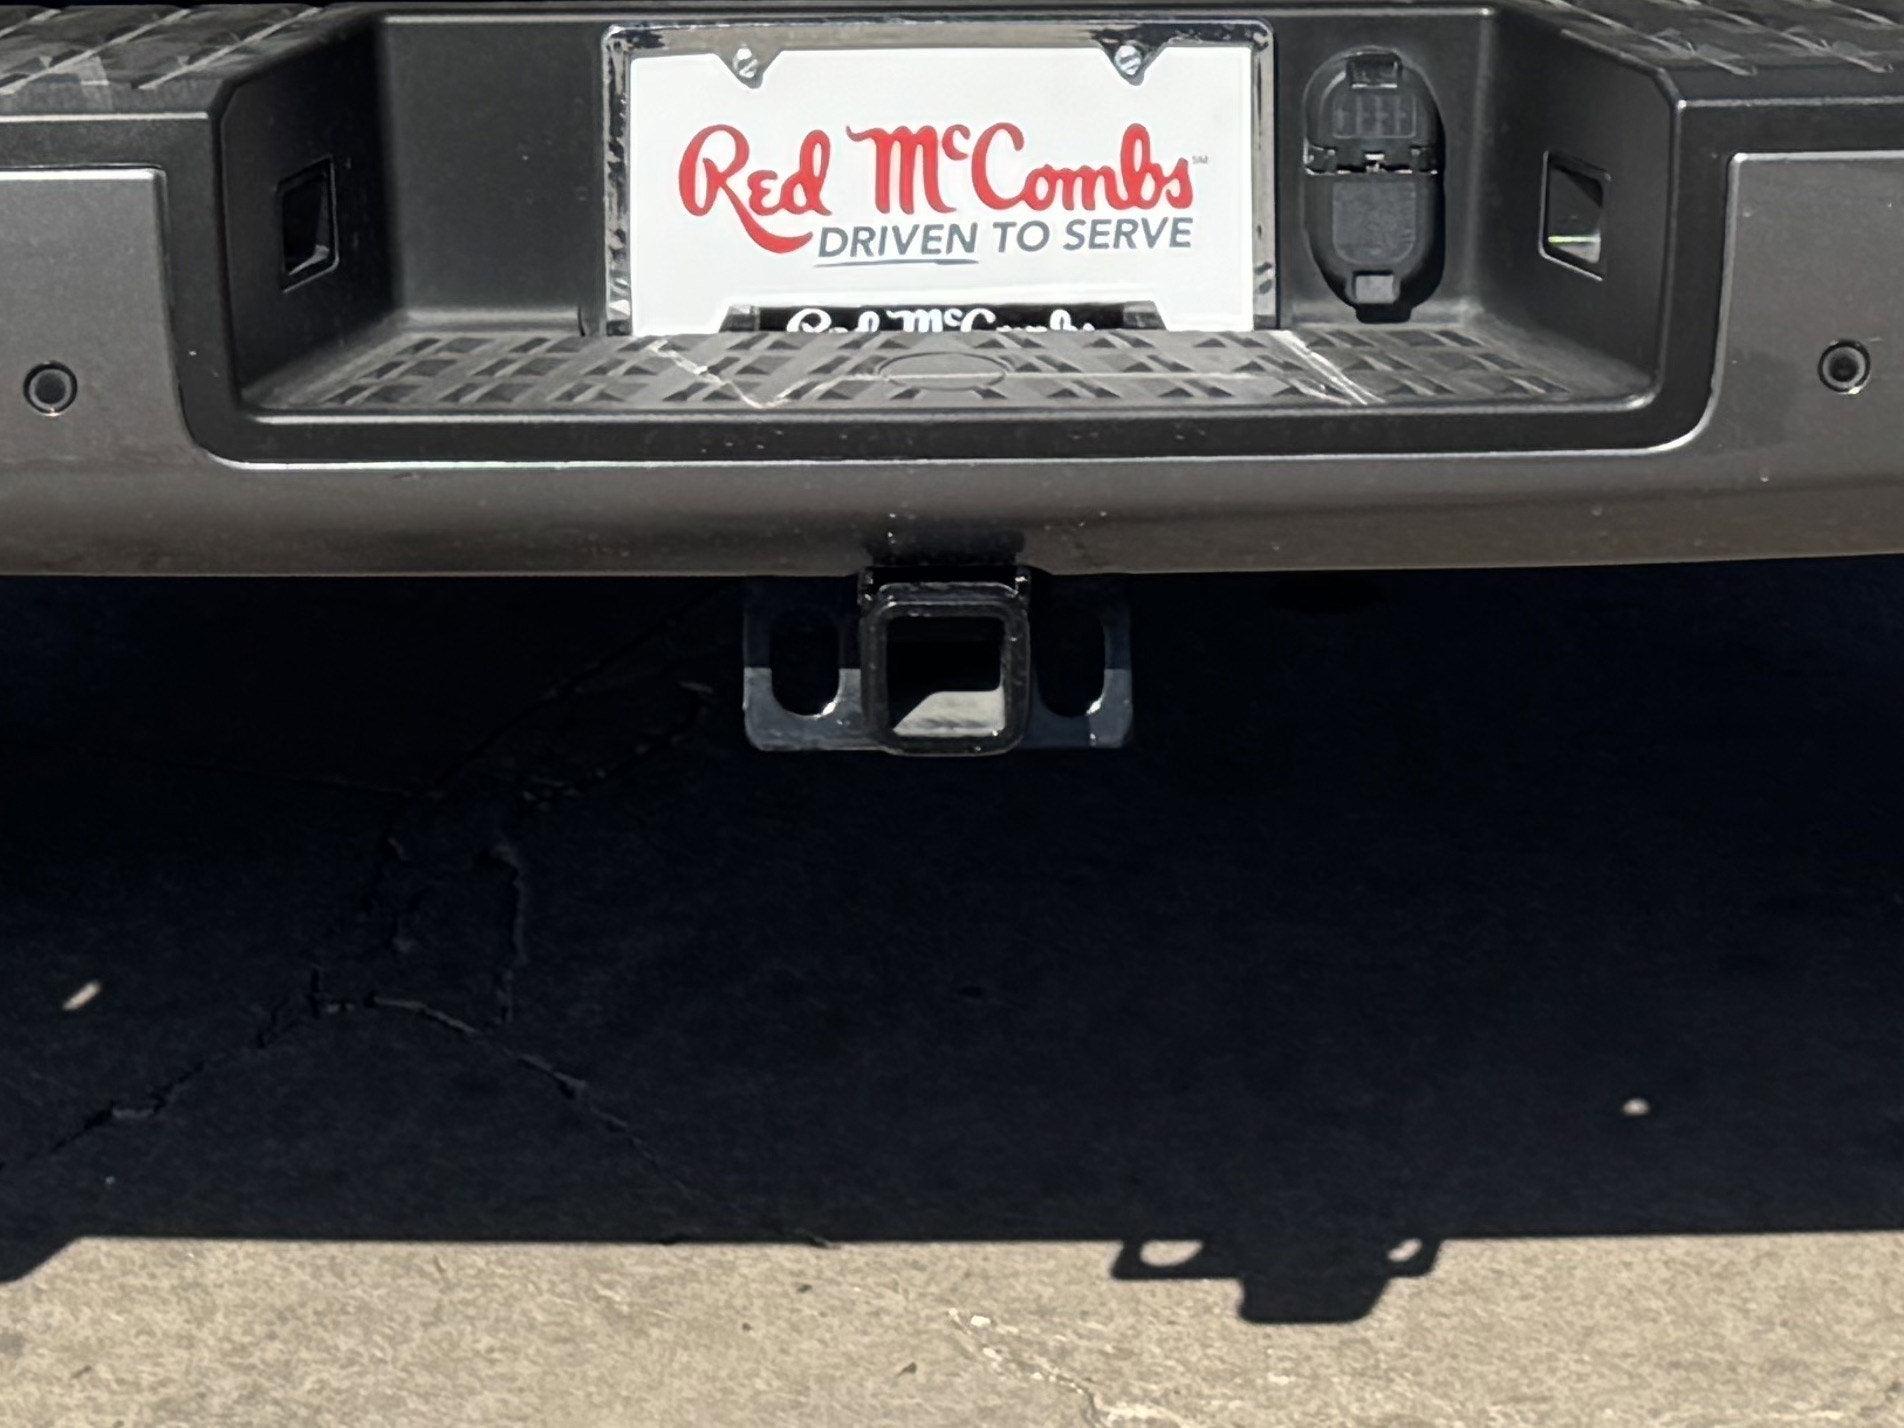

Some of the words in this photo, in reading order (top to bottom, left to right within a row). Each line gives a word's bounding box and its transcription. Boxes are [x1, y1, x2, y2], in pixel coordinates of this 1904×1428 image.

[678, 123, 832, 254] Red
[845, 122, 1193, 214] McCombs
[817, 222, 978, 258] DRIVEN
[993, 219, 1050, 254] TO
[1064, 216, 1194, 250] SERVE
